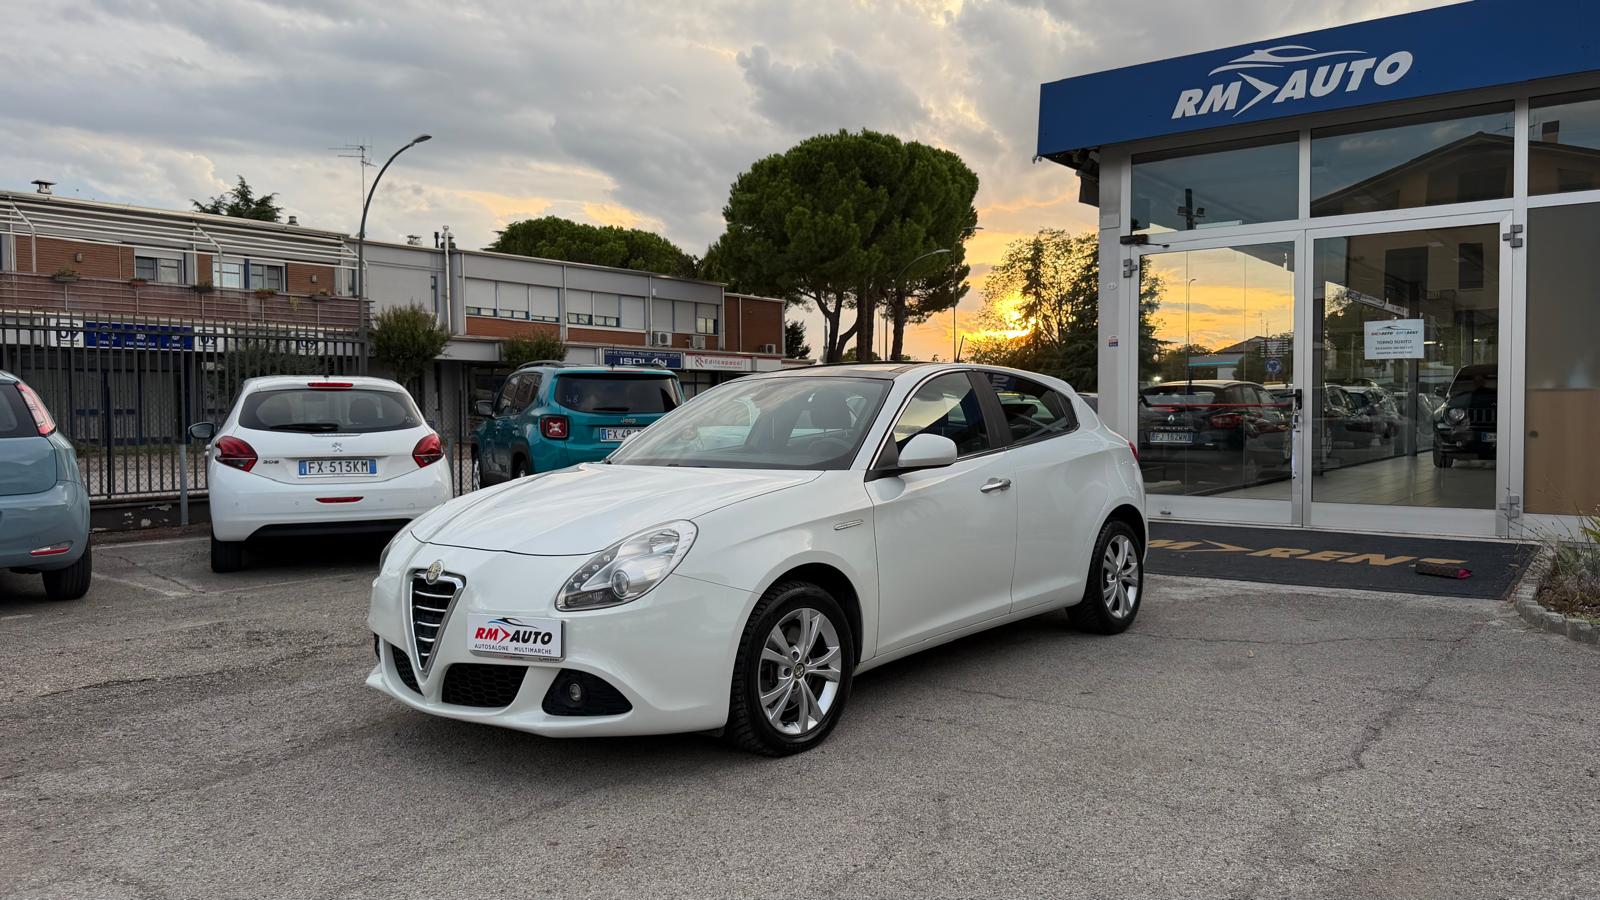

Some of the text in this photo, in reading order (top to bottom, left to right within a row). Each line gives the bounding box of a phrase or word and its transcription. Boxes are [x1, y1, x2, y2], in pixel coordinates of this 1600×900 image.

[1171, 51, 1413, 119] RM AUTO
[308, 461, 368, 473] FX 513KM
[474, 627, 552, 645] RM AUTO
[474, 643, 508, 651] AUTOSALONE
